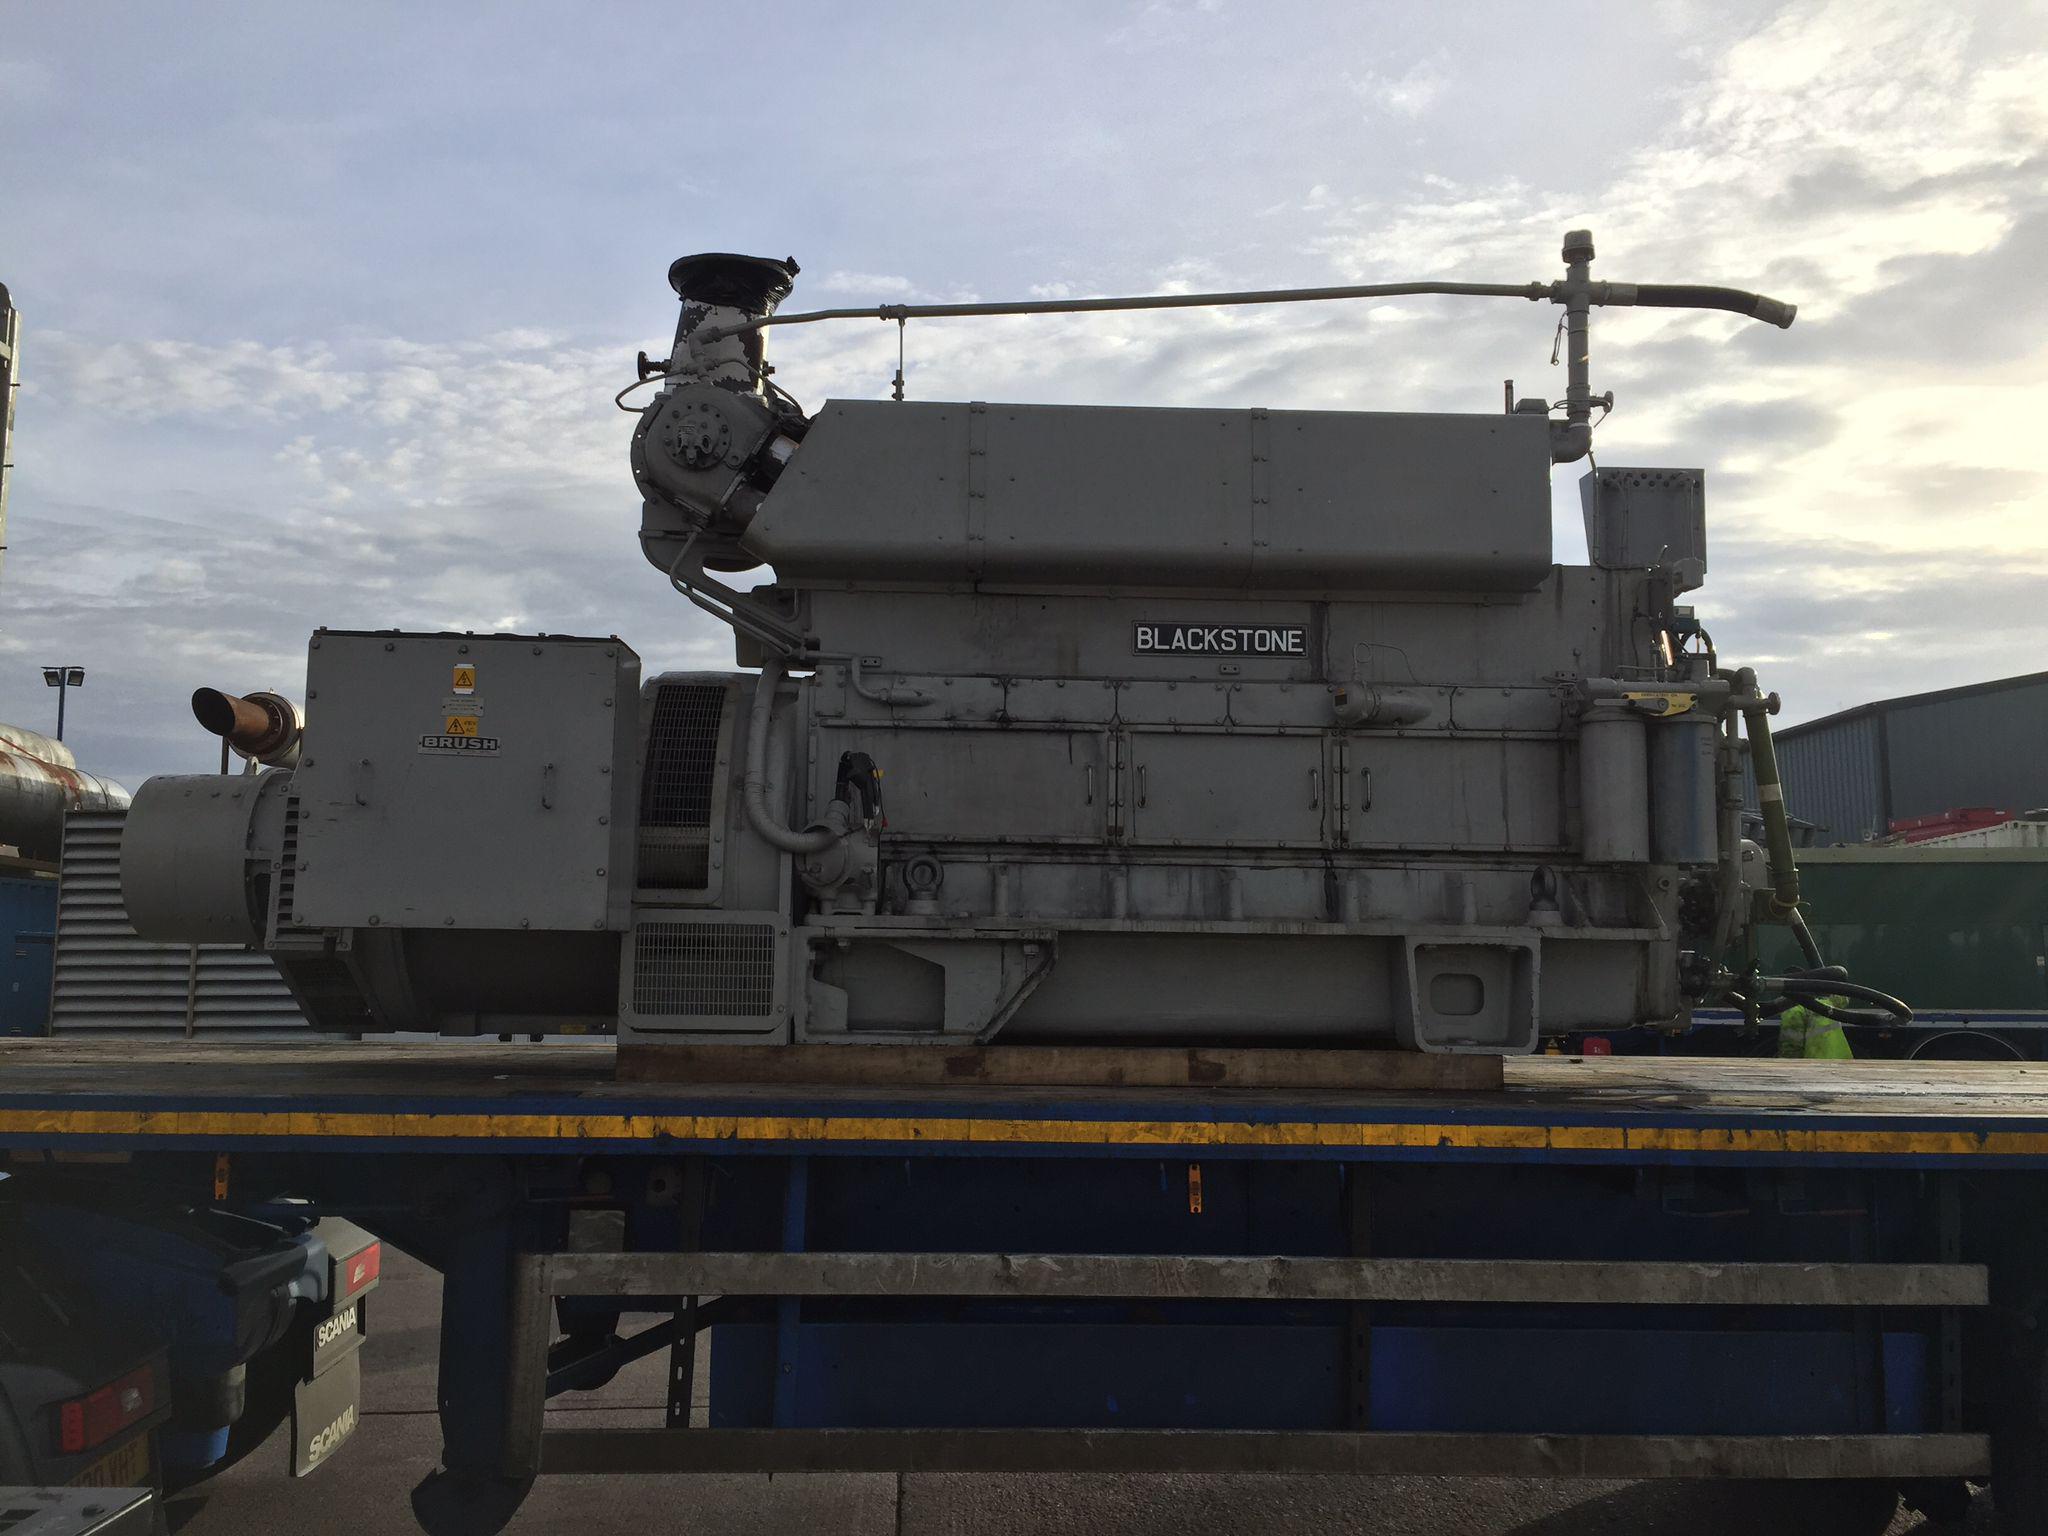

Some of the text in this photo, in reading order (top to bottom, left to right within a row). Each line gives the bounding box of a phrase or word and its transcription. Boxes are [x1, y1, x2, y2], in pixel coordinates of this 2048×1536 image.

[1137, 627, 1303, 652] BLACKSTONE
[424, 737, 496, 749] BRUSH
[318, 1307, 356, 1348] SCANIA
[309, 1404, 355, 1462] SCANIA
